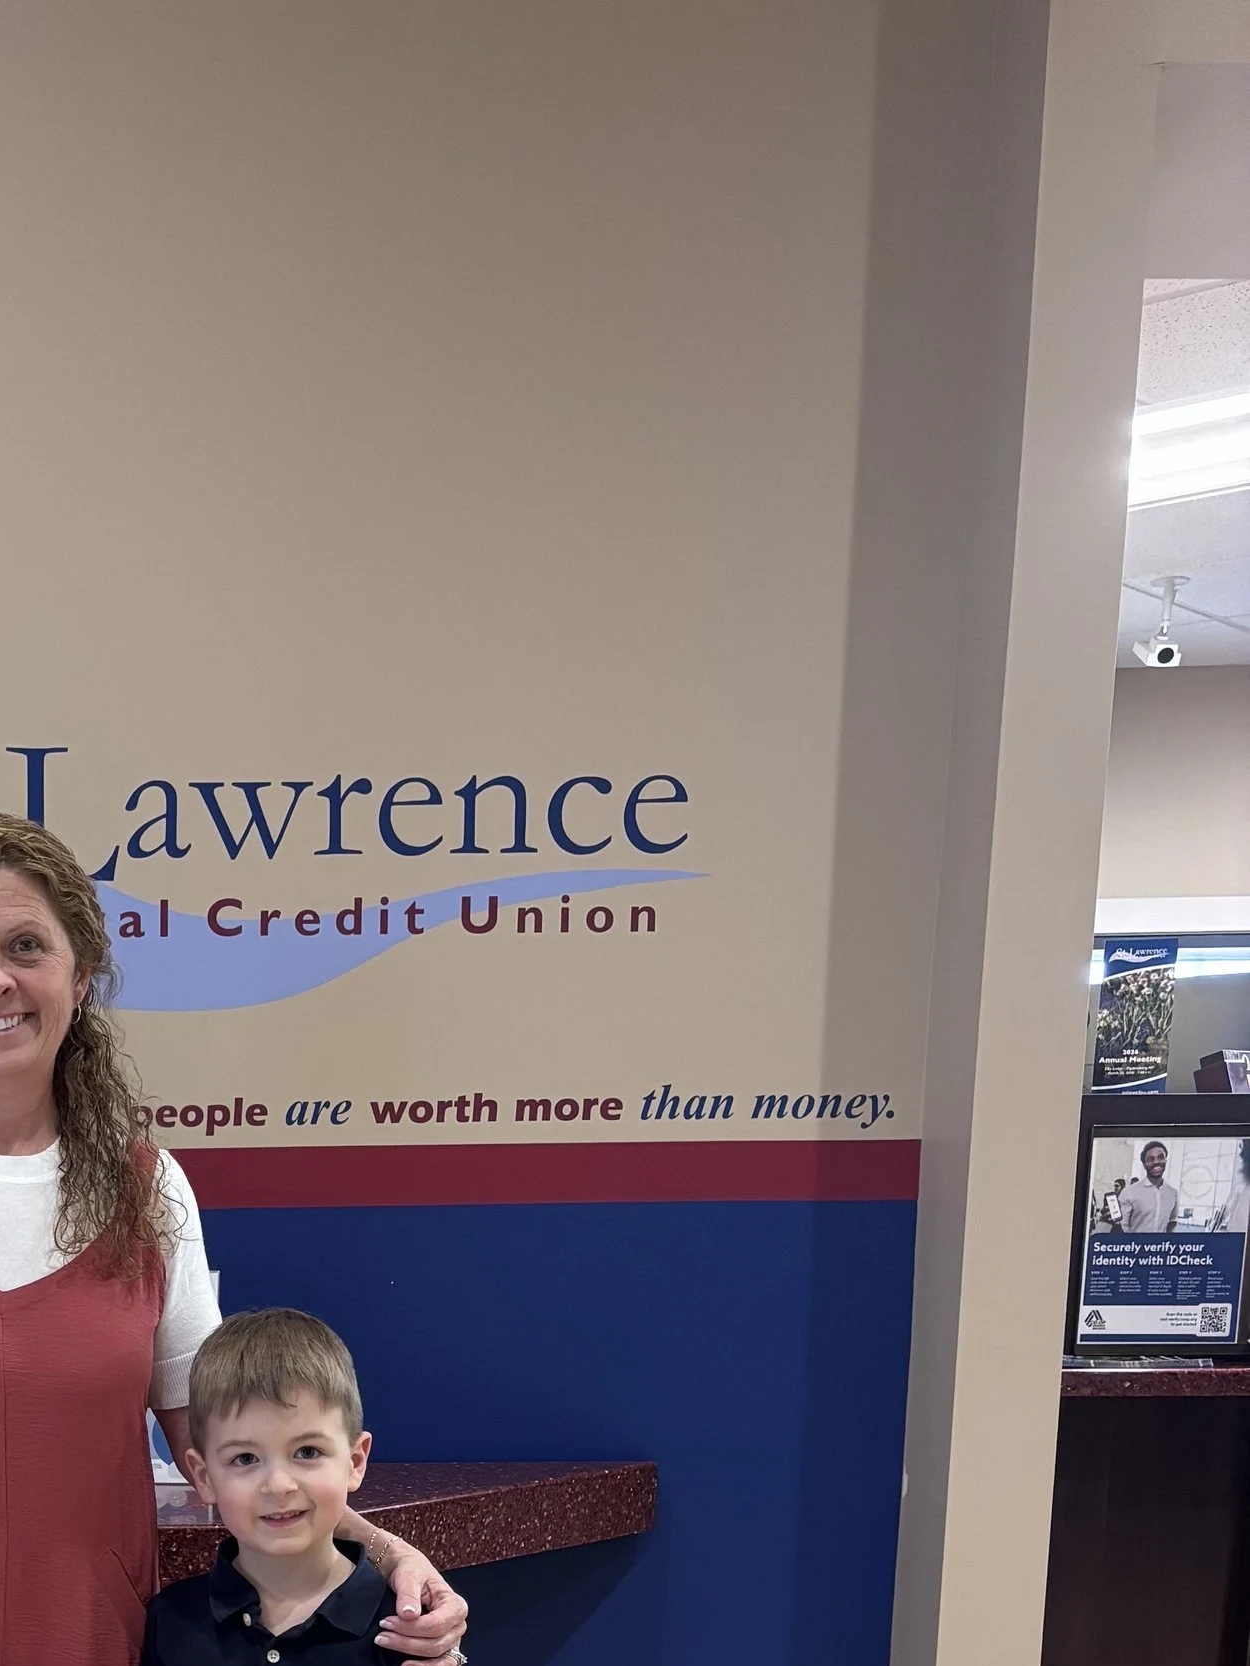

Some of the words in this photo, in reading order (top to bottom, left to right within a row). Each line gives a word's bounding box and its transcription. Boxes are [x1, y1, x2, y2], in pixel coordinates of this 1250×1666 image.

[5, 747, 689, 881] Lawrence
[207, 896, 425, 937] Credit
[461, 894, 656, 935] Union
[285, 1099, 353, 1126] are
[369, 1092, 498, 1124] worth
[515, 1097, 624, 1122] more
[640, 1084, 734, 1121] than
[750, 1093, 895, 1130] money.
[1093, 1256, 1136, 1267] identity
[1138, 1256, 1163, 1265] with
[1166, 1255, 1213, 1265] IDCheck
[1094, 1242, 1141, 1254] Securely
[1144, 1242, 1175, 1254] verify
[1179, 1244, 1204, 1254] your
